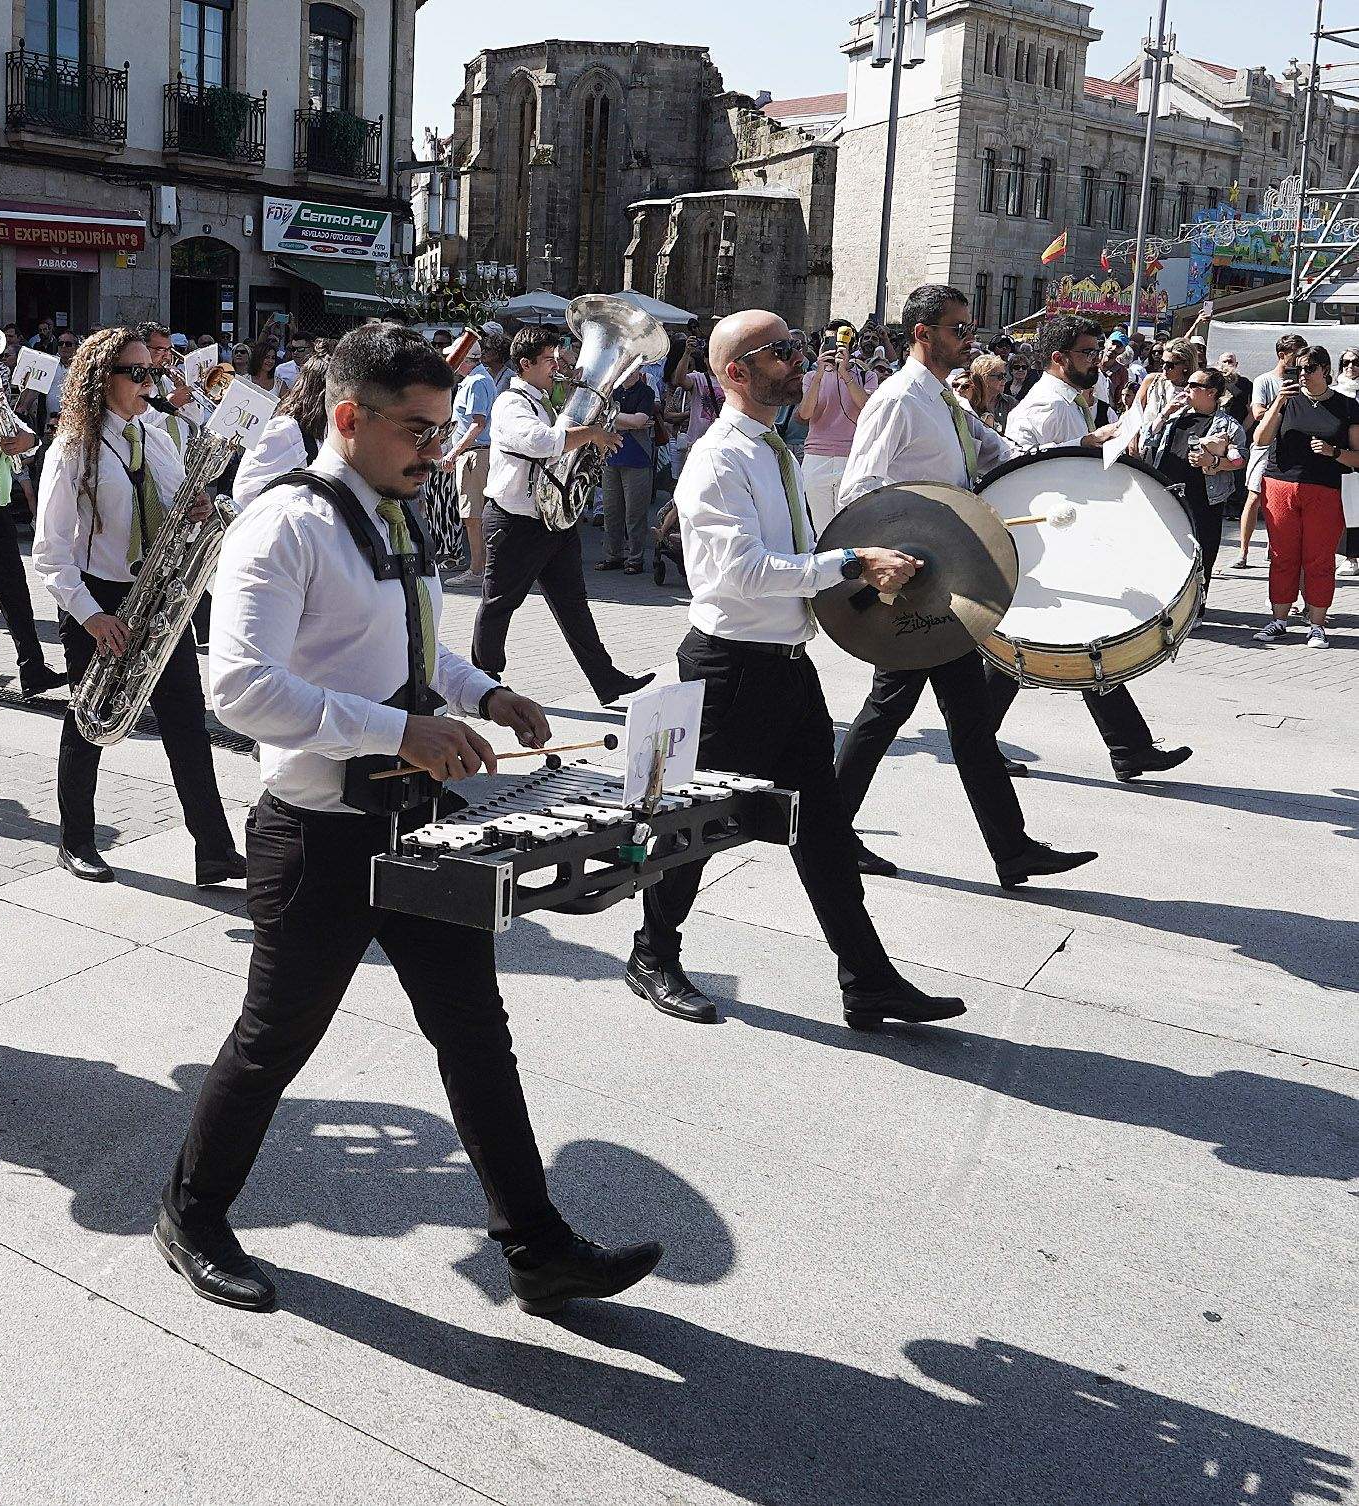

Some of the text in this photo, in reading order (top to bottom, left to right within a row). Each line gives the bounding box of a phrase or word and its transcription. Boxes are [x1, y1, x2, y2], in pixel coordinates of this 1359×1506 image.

[14, 227, 115, 246] EXPENDEDURÍA
[301, 229, 363, 242] REVELADO FOTO DIGITAL
[37, 258, 78, 269] TABACOS
[895, 611, 956, 637] Zildjian
